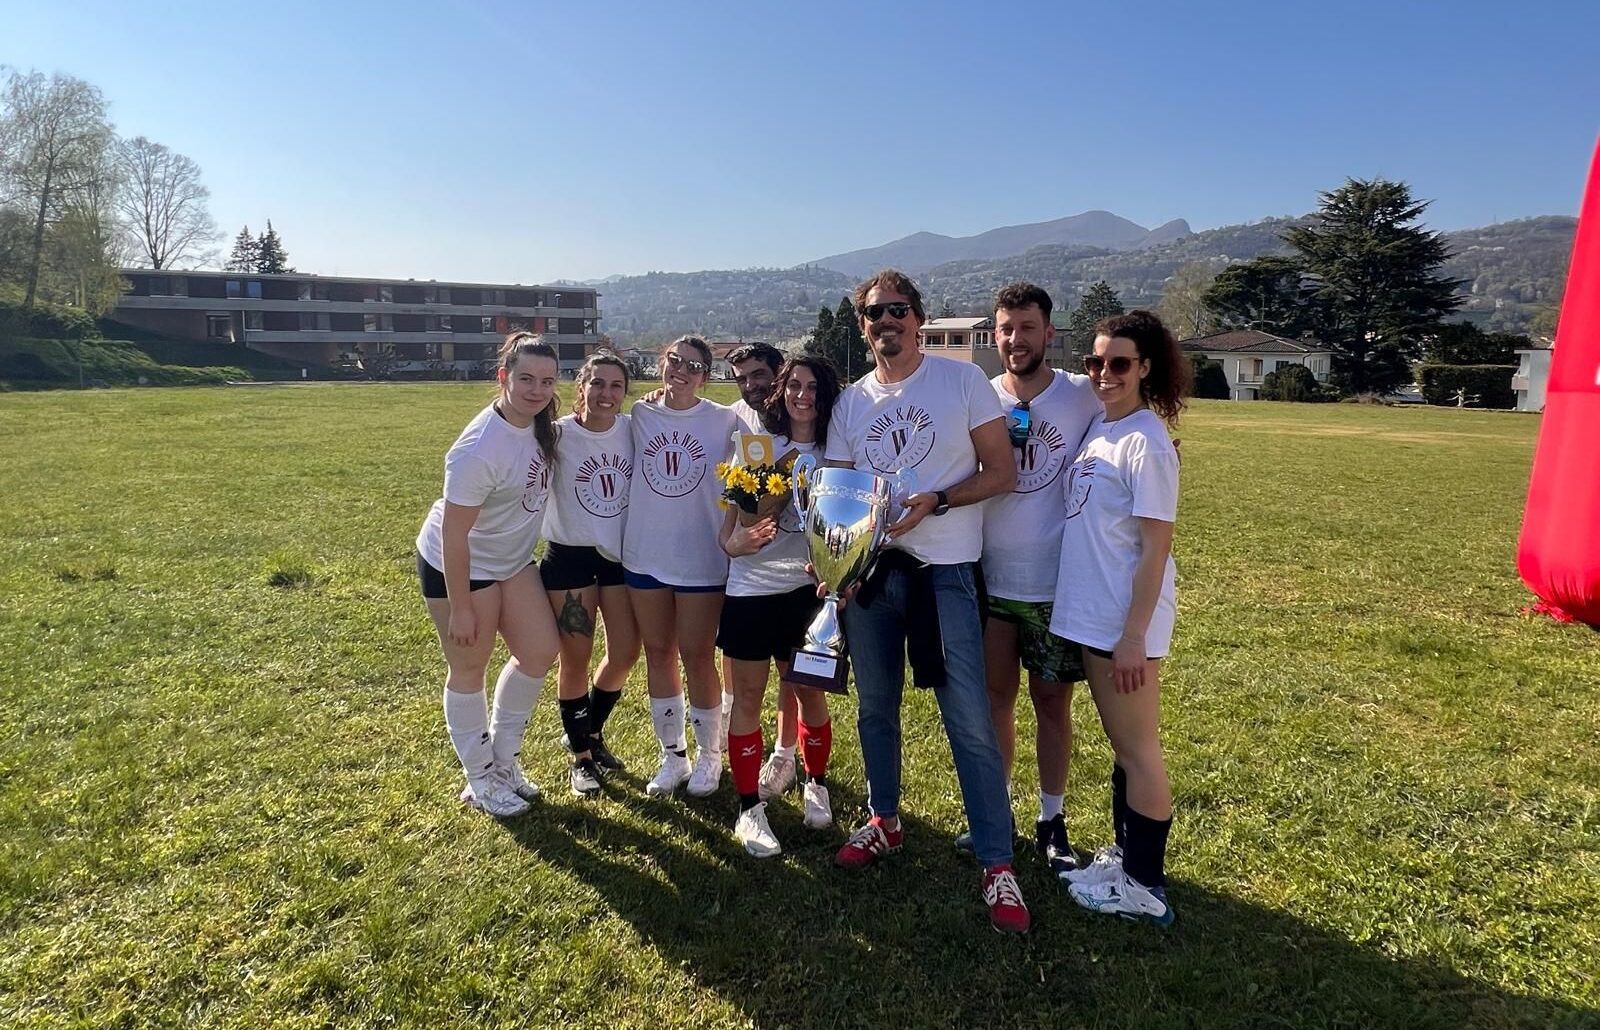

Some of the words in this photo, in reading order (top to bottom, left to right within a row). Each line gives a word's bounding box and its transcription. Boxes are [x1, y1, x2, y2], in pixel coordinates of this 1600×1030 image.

[866, 413, 895, 442] WORK
[896, 407, 905, 421] &
[1037, 420, 1067, 453] WORK
[643, 432, 670, 458] WORK
[672, 430, 679, 444] &
[681, 432, 707, 462] WORK
[891, 426, 909, 457] W
[1020, 443, 1040, 471] W
[575, 455, 601, 483] WORK
[601, 452, 610, 467] &
[664, 450, 683, 476] W
[599, 473, 616, 498] W
